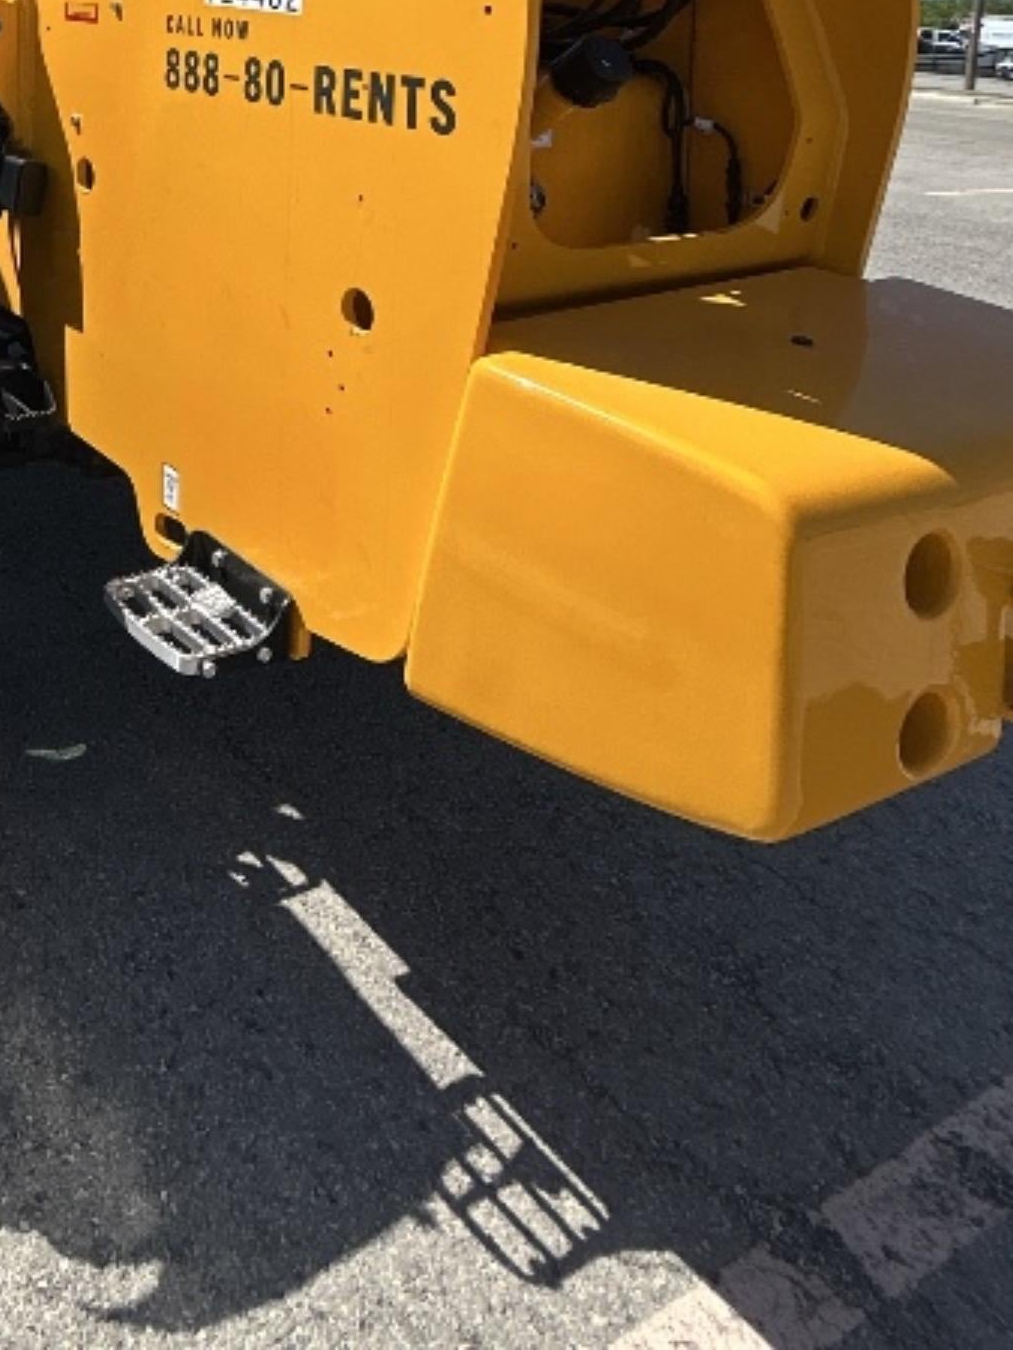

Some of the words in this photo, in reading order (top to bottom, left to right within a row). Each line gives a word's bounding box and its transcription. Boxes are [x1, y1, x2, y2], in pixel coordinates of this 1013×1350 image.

[166, 15, 204, 37] CALL
[211, 18, 249, 40] NOW
[165, 48, 456, 135] 888-80-RENTS
